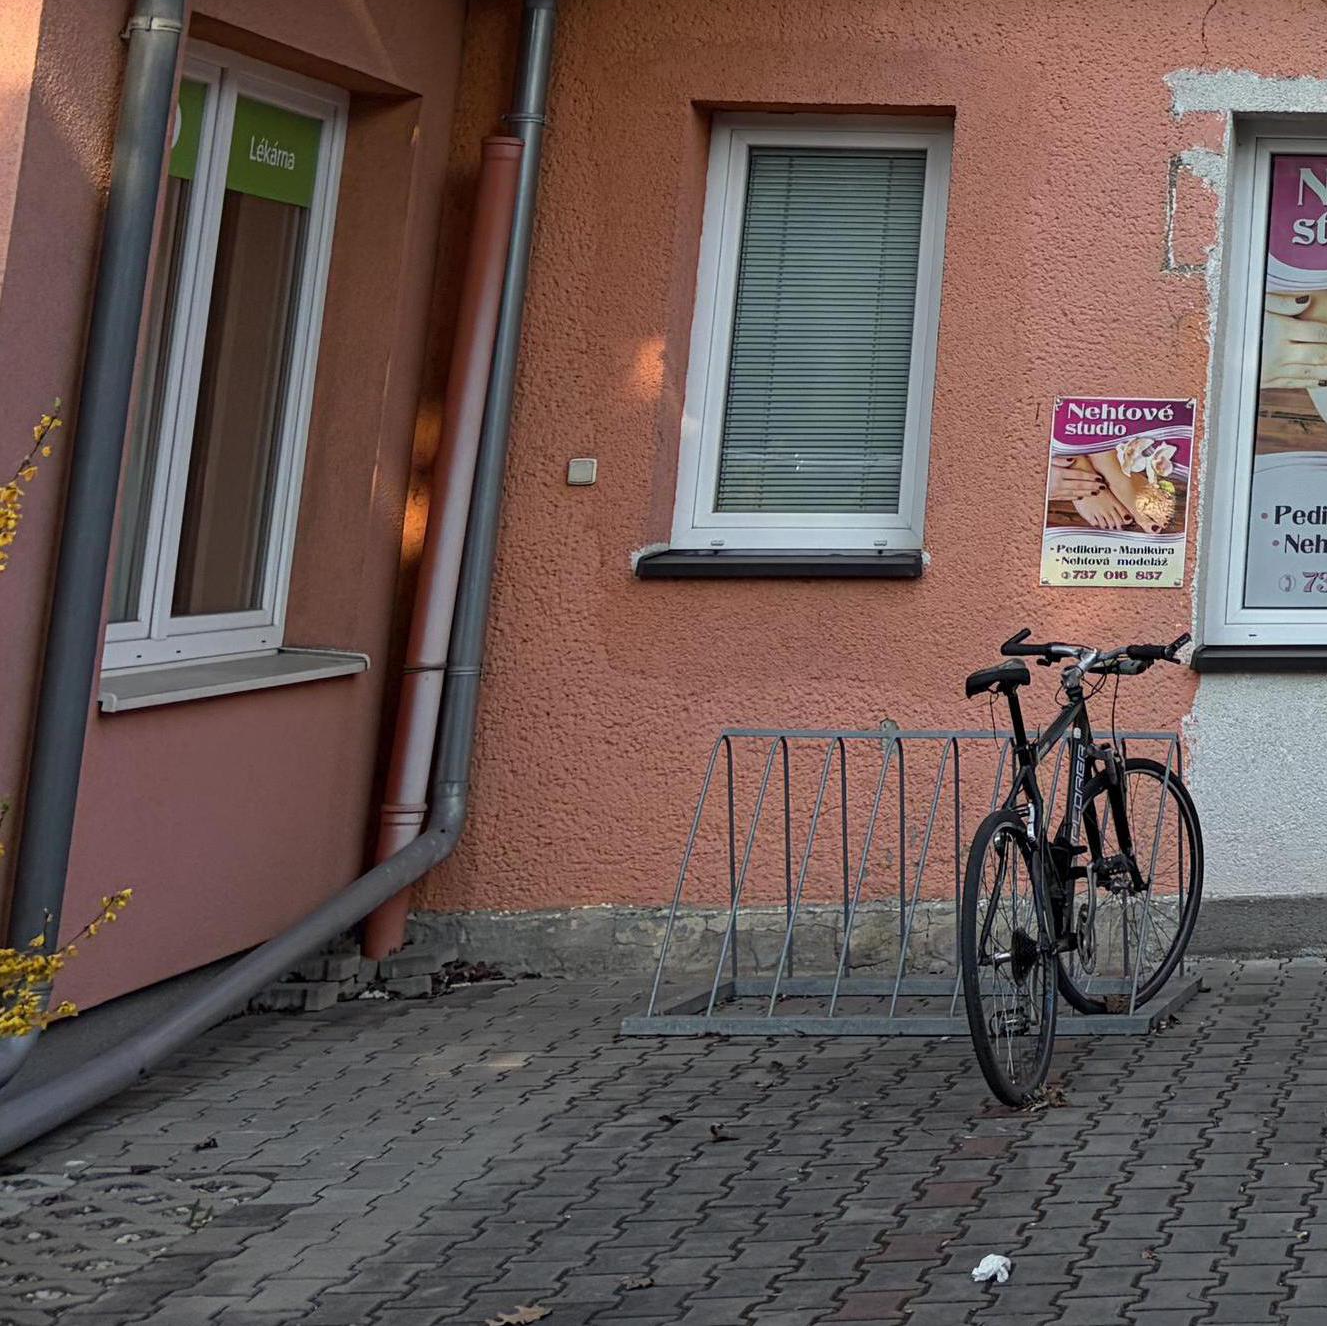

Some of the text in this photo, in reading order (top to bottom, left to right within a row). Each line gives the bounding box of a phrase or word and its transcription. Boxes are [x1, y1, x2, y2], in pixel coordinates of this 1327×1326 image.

[249, 135, 296, 171] Lékárna
[1067, 402, 1174, 421] Nehtové
[1064, 421, 1127, 436] studio
[1057, 544, 1175, 555] Pedikúra Manikúra
[1061, 556, 1168, 567] Nehtová modeláž
[1072, 570, 1163, 580] 737 016 857
